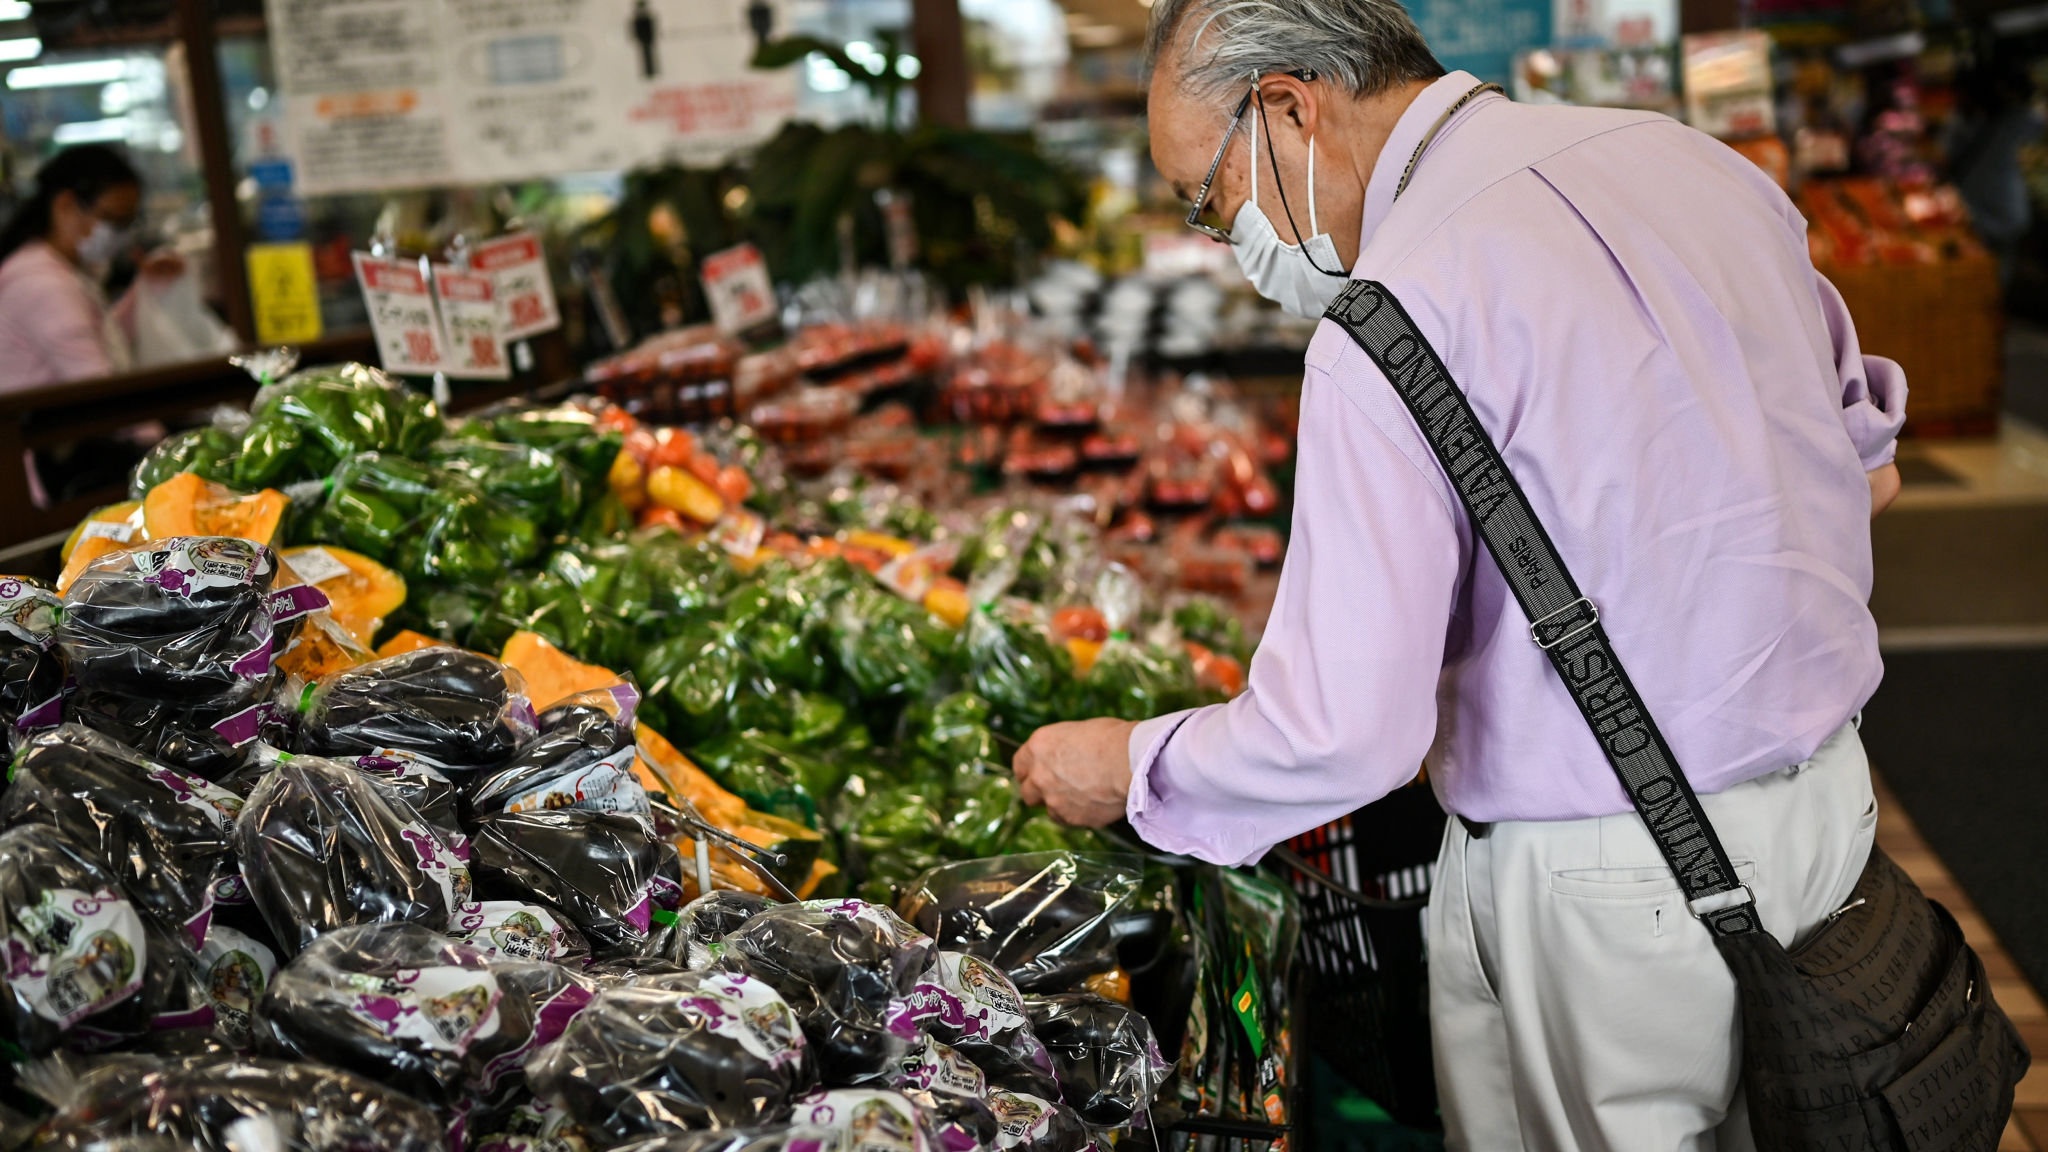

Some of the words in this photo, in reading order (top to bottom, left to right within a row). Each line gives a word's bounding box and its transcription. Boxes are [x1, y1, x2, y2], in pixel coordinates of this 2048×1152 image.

[1382, 332, 1510, 524] VALENTINO
[1508, 535, 1550, 590] PARIS
[1636, 775, 1732, 895] ENTINO
